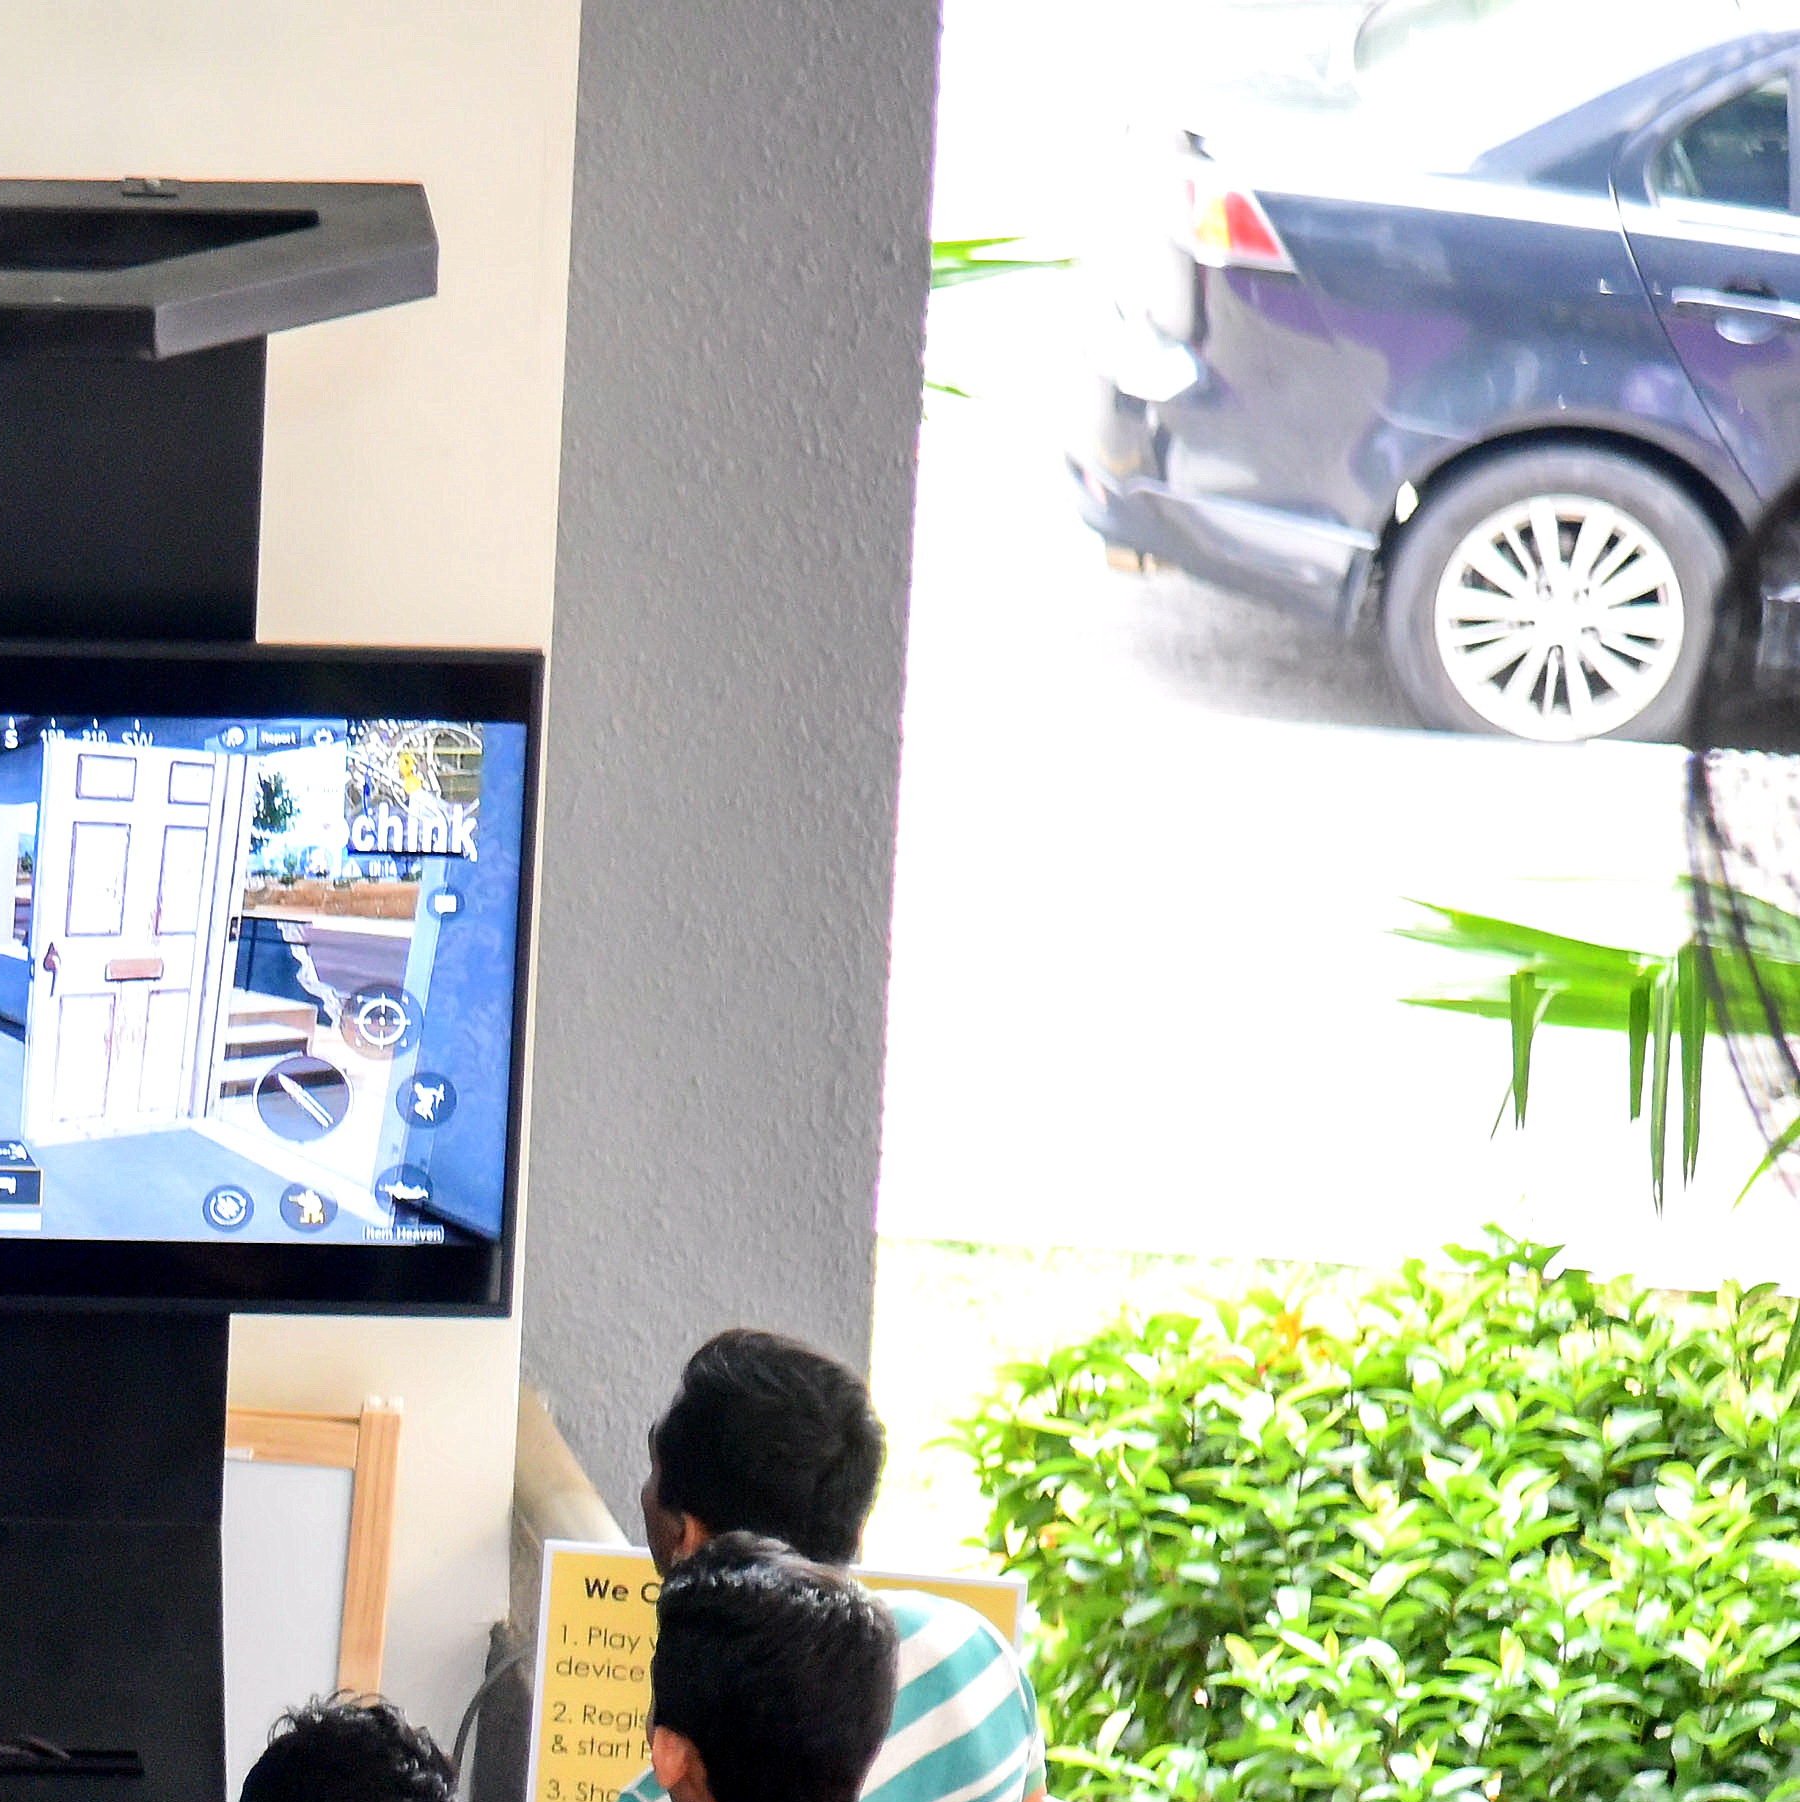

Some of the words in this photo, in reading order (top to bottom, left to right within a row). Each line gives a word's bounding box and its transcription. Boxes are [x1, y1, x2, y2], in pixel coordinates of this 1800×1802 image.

[4, 730, 19, 749] S
[584, 1577, 629, 1602] We
[561, 1624, 578, 1647] 1.
[588, 1625, 641, 1655] Play
[553, 1702, 572, 1724] 2.
[551, 1734, 568, 1755] &
[577, 1737, 631, 1760] start
[546, 1779, 567, 1801] 3.
